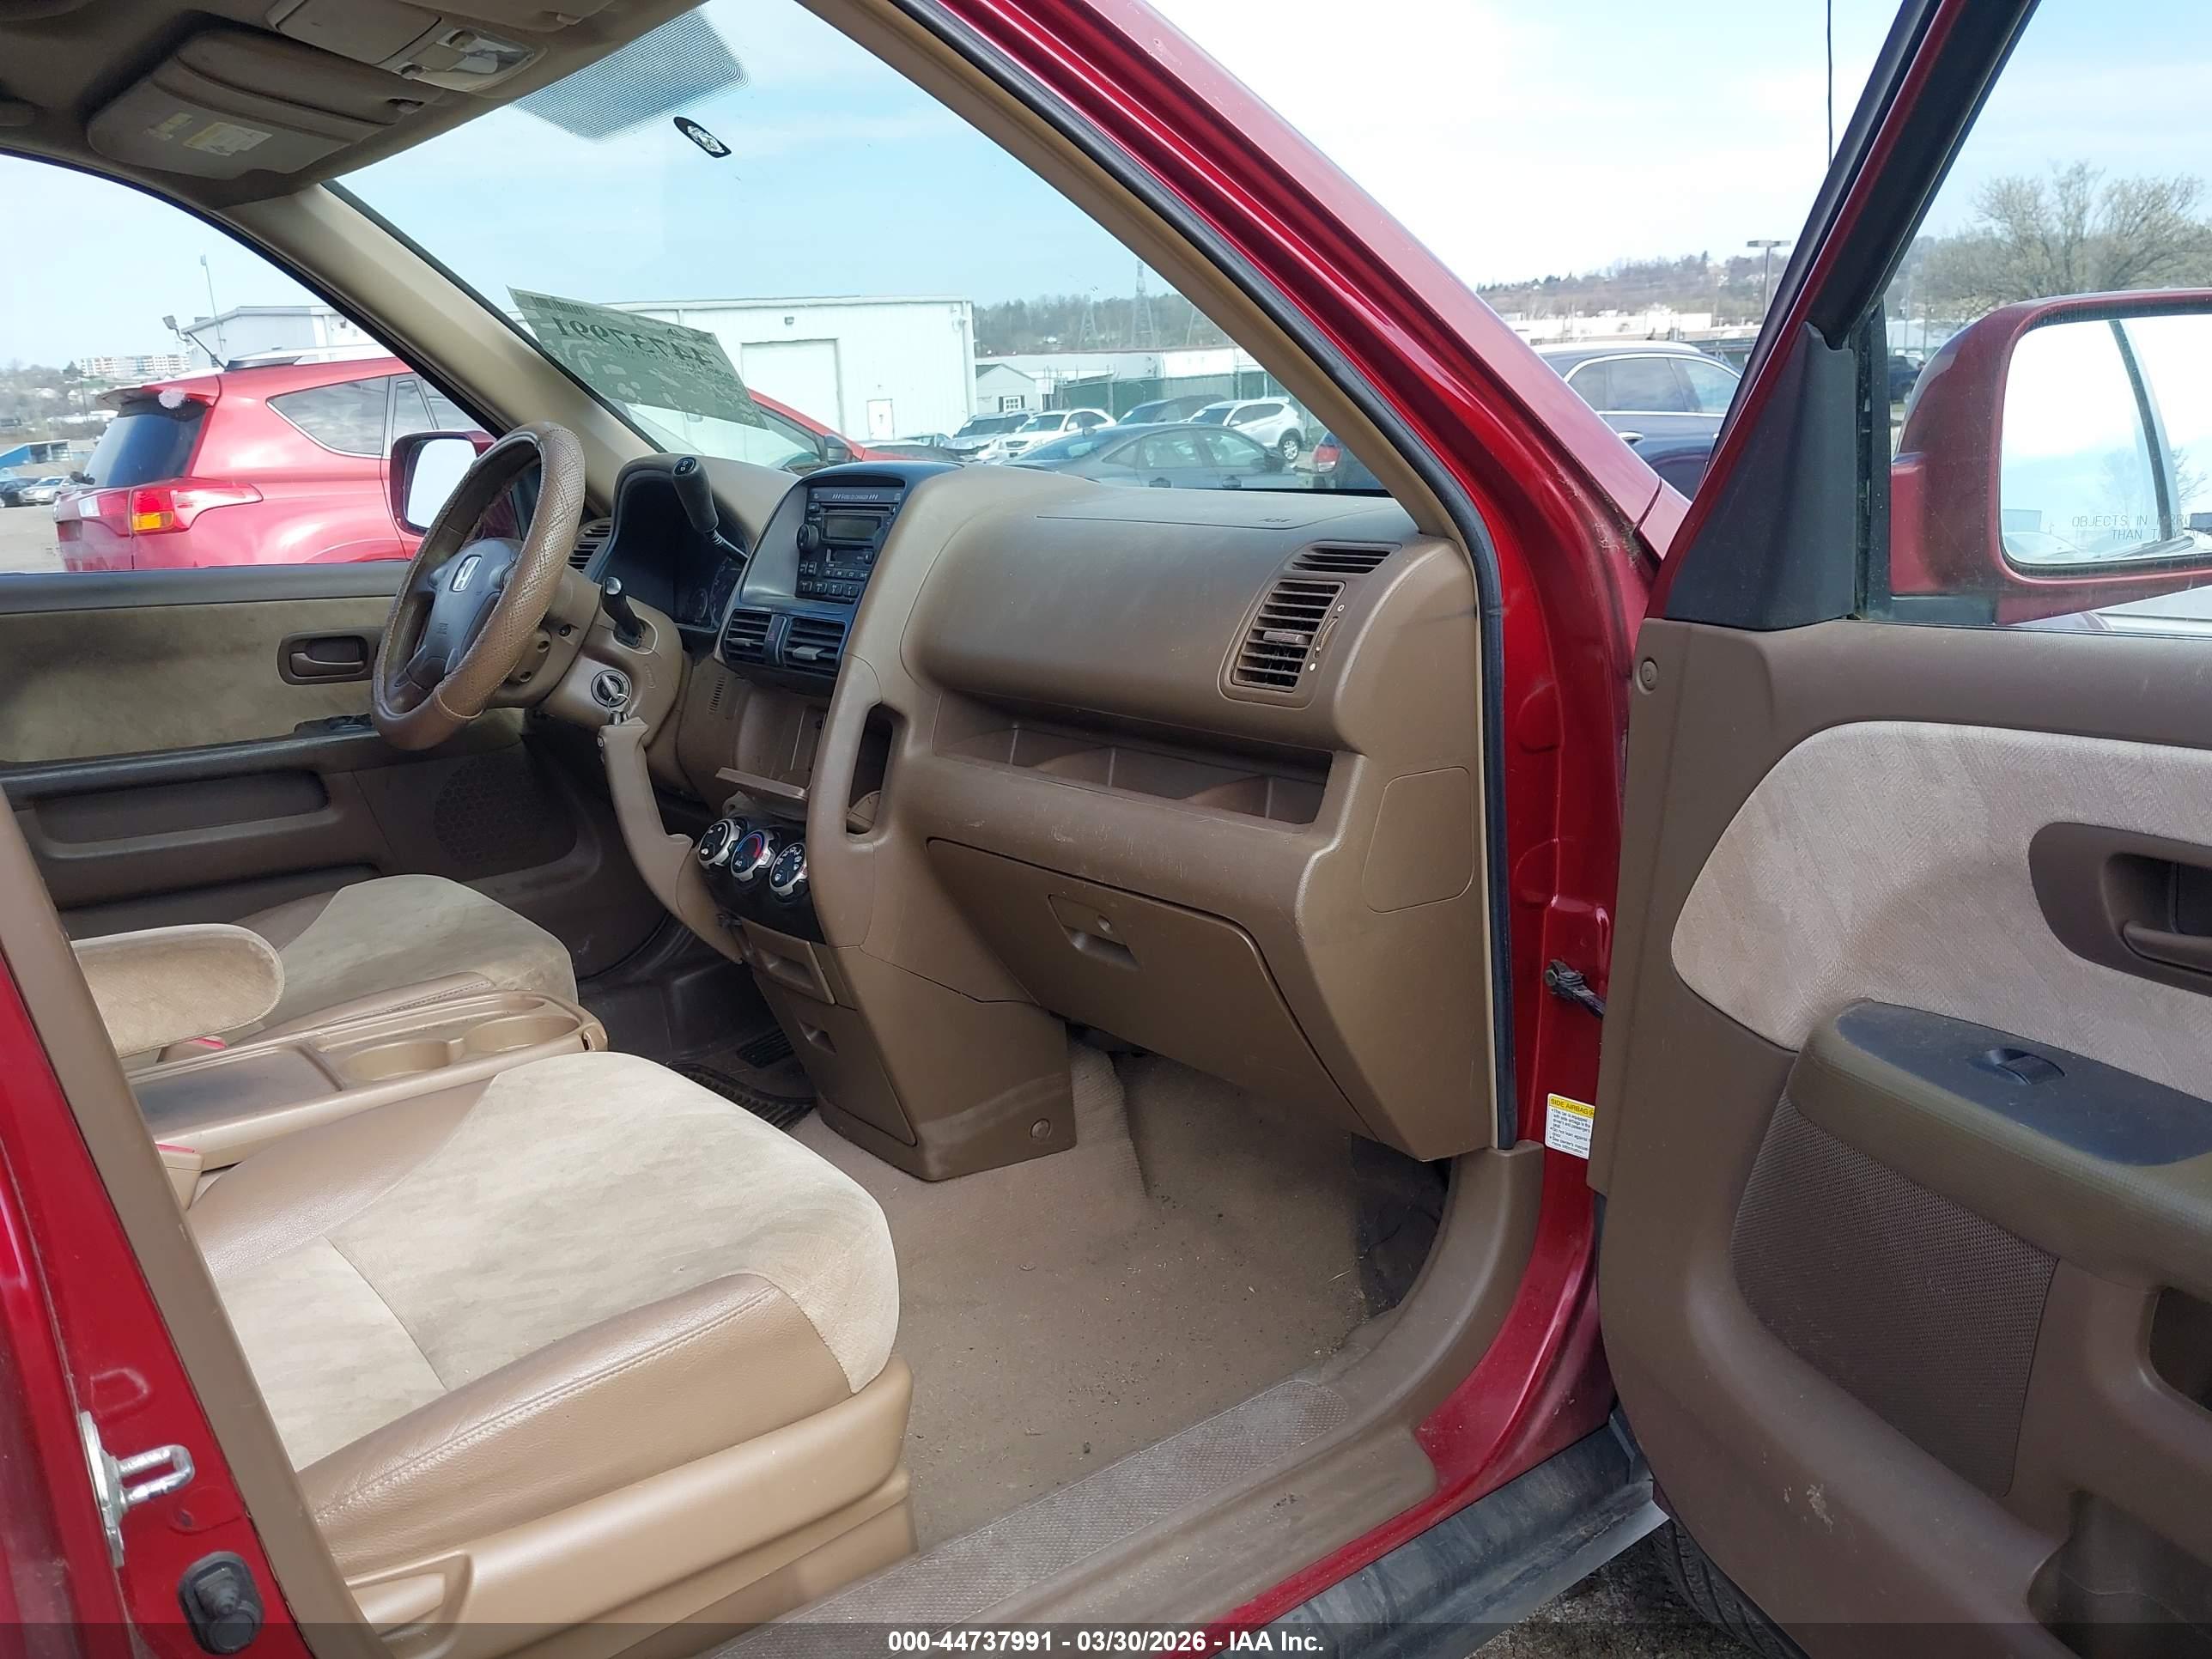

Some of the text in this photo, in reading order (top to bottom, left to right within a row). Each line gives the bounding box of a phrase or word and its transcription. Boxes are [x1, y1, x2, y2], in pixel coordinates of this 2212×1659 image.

[2071, 514, 2128, 527] OBJECTS
[2136, 514, 2148, 526] IN
[2112, 528, 2143, 540] THAN
[1550, 1098, 1589, 1115] SIDE AIRBAG
